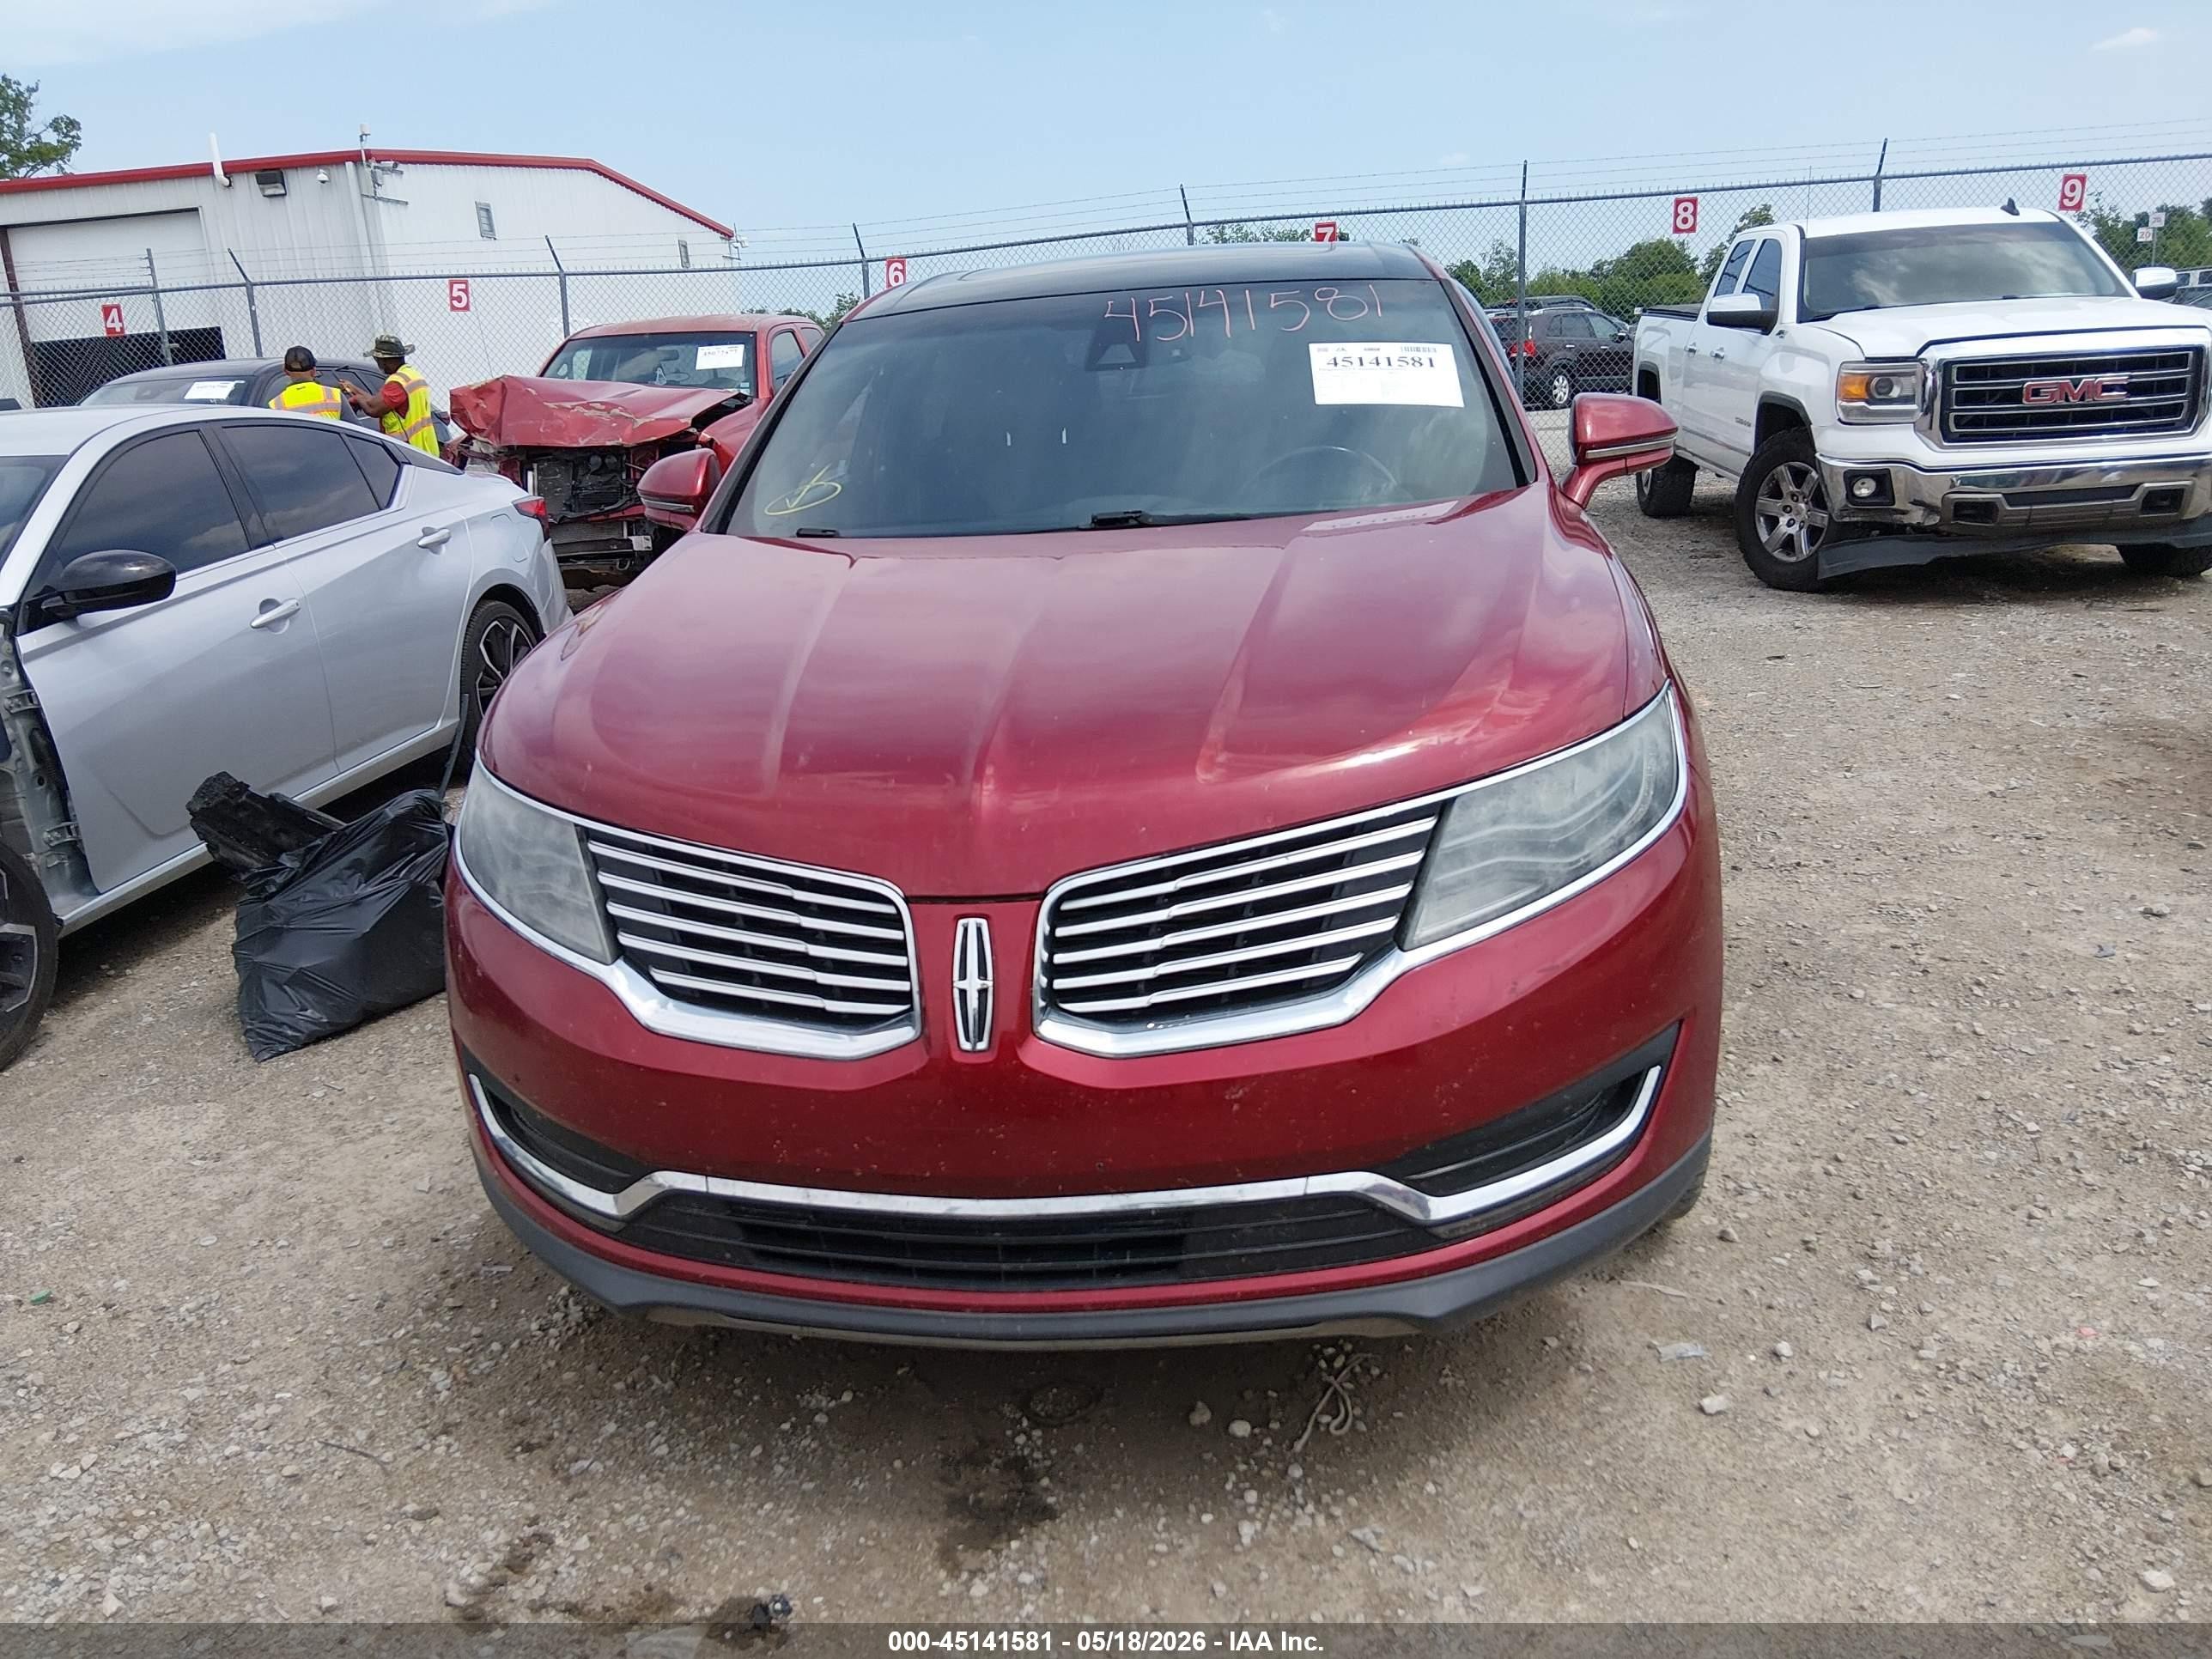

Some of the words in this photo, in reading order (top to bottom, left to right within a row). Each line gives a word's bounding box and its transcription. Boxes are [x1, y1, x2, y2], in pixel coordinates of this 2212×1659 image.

[2063, 179, 2082, 207] 9
[1676, 201, 1694, 229] 8
[1316, 227, 1334, 242] 7
[2139, 231, 2151, 240] 20
[889, 262, 904, 288] 6
[452, 283, 467, 307] 5
[106, 307, 123, 332] 4
[1104, 284, 1382, 342] 45141581
[1326, 356, 1435, 368] 45141581
[2022, 376, 2130, 404] GMC
